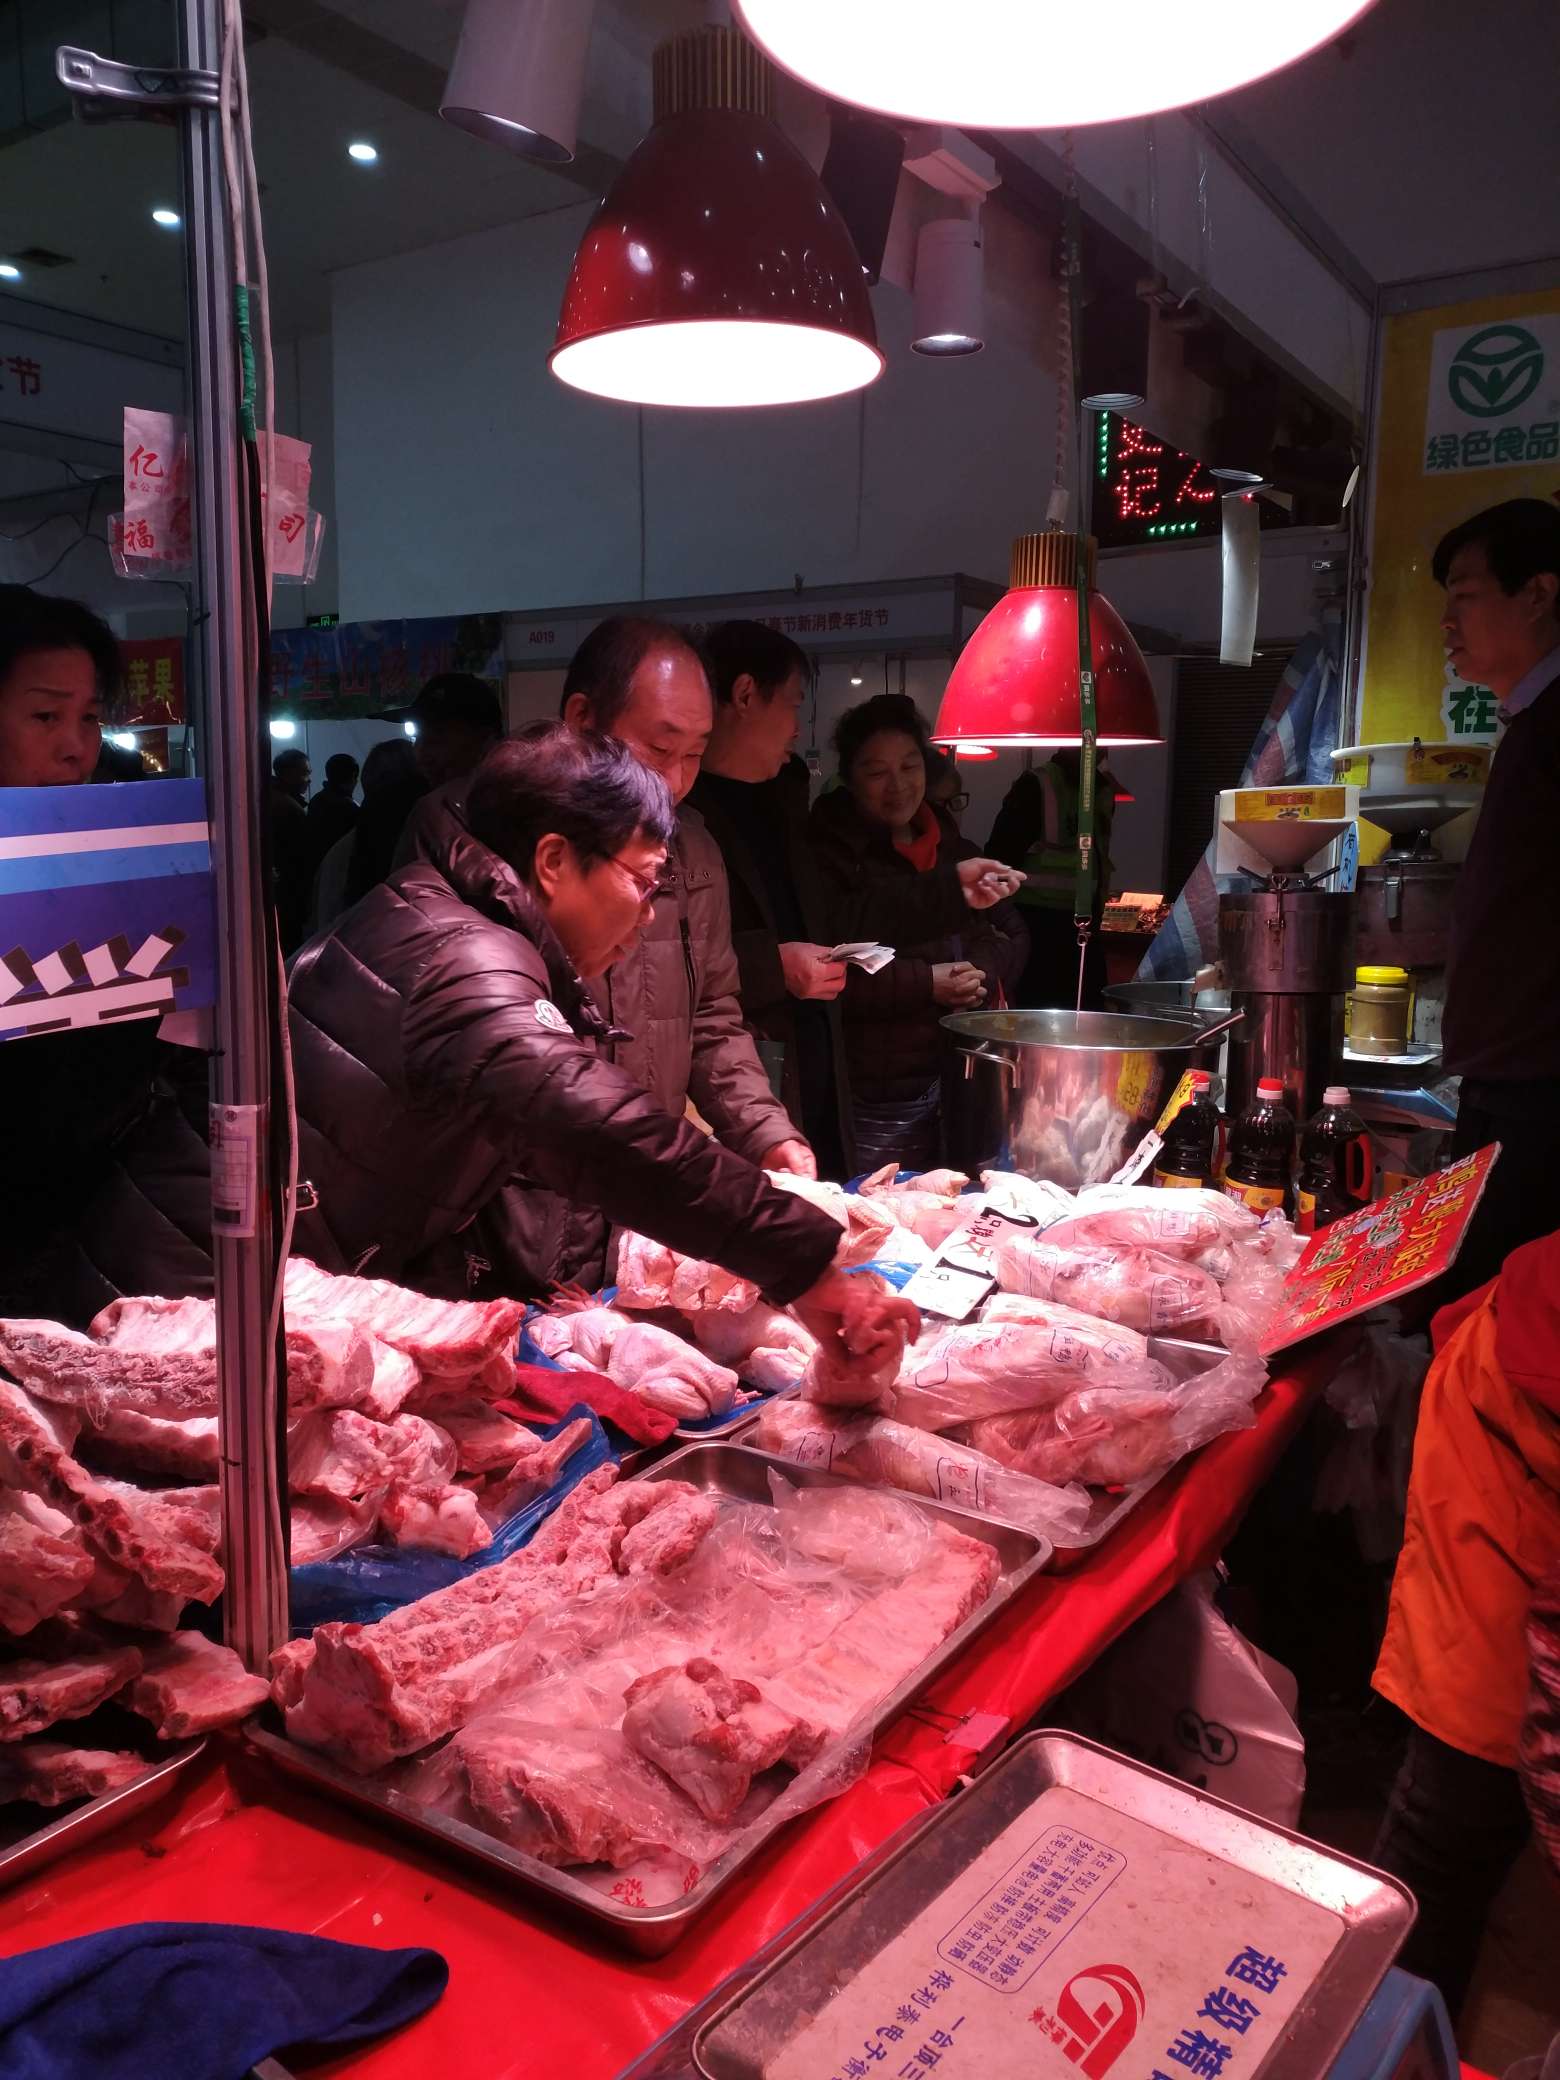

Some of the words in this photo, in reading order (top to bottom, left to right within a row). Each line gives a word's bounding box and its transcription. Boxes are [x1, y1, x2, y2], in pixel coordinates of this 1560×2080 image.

[1426, 421, 1560, 470] 绿色食品
[529, 630, 555, 645] A019
[128, 657, 175, 706] 苹果
[830, 1969, 956, 2080] 桦利泰电子衡
[1151, 1945, 1288, 2080] 超级精
